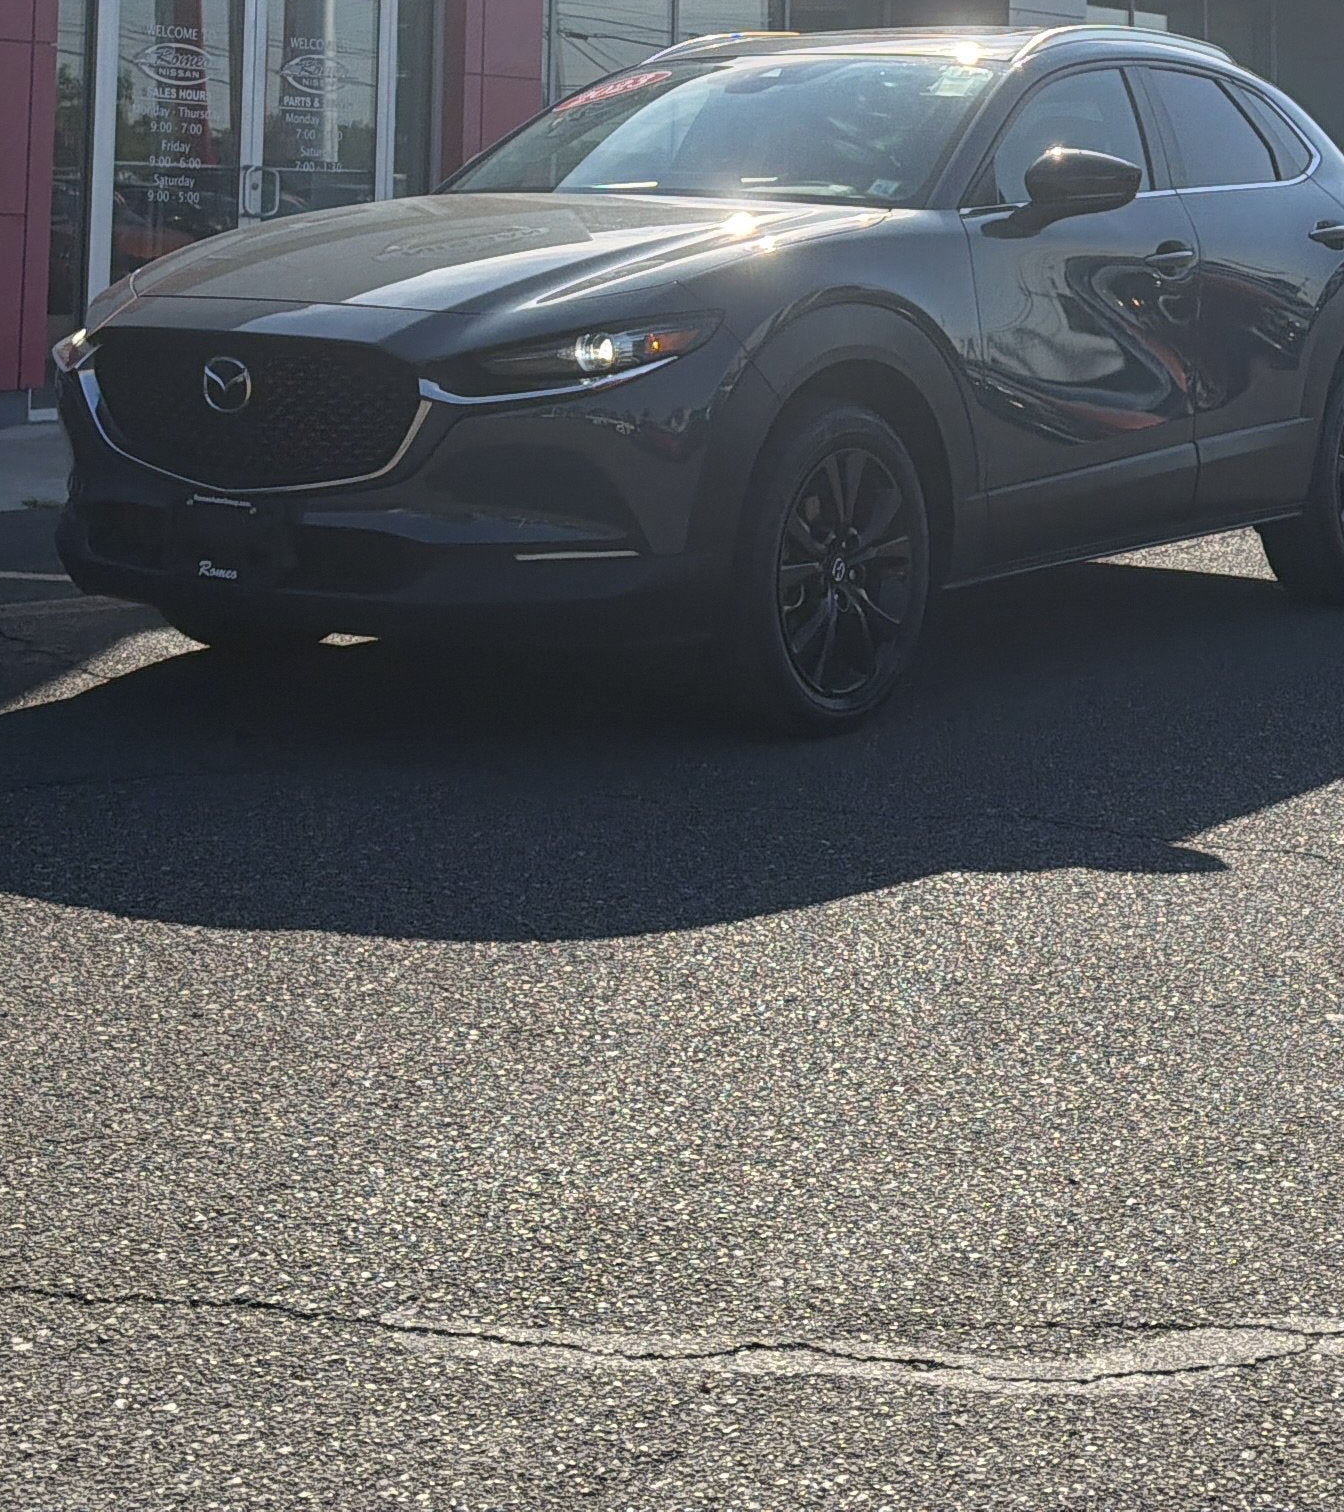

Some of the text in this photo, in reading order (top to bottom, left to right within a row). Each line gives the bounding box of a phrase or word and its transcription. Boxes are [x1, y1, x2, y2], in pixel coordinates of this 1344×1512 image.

[146, 24, 199, 40] WELCOME
[158, 67, 201, 79] NISSAN
[147, 87, 177, 100] SALES
[283, 95, 312, 108] PARTS
[285, 112, 321, 126] Monday
[150, 120, 173, 134] 9:00
[180, 122, 203, 136] 7:00
[161, 139, 192, 155] Friday
[148, 155, 172, 168] 9:00
[179, 157, 202, 170] 6:00
[153, 173, 196, 189] Saturday
[147, 189, 171, 203] 9:00
[178, 191, 201, 204] 5:00
[198, 560, 238, 579] Romeo
